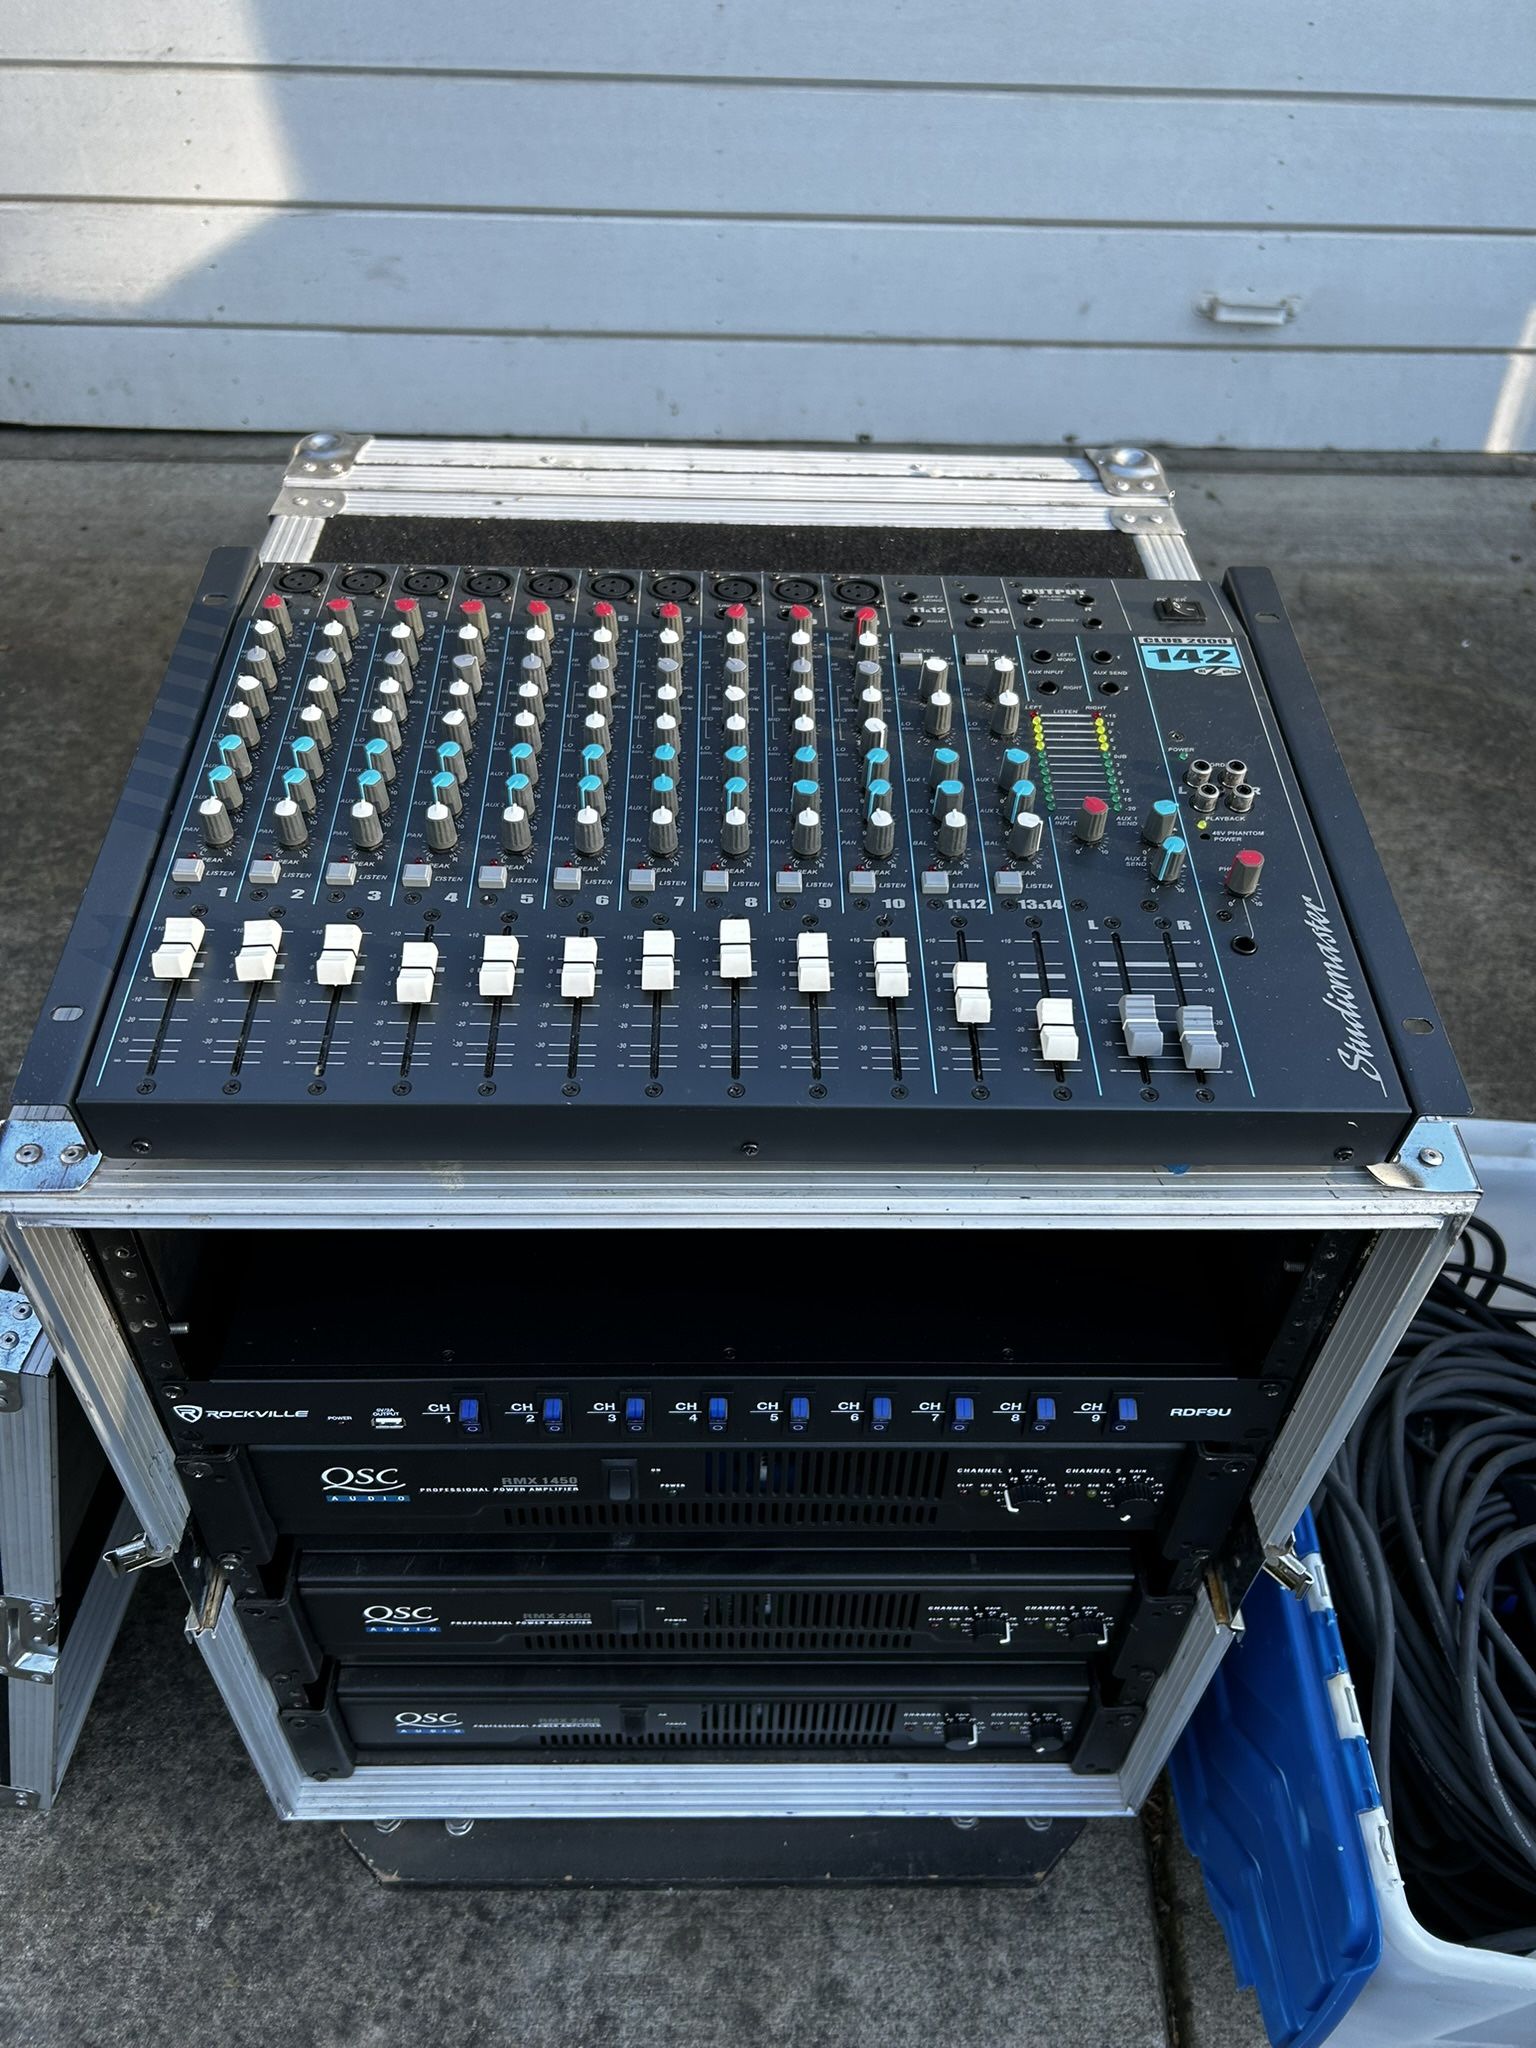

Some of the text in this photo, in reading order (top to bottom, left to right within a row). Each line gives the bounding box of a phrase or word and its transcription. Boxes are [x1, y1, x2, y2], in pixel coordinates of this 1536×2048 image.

[1148, 649, 1233, 663] 142
[217, 887, 229, 897] 1
[290, 889, 305, 899] 2
[367, 891, 382, 900] 3
[444, 893, 458, 902] 4
[520, 894, 534, 904] 5
[595, 895, 609, 905] 6
[673, 896, 685, 906] 7
[744, 897, 758, 907] 8
[818, 898, 832, 908] 9
[882, 899, 906, 909] 10
[945, 899, 987, 909] 11&12
[1018, 899, 1063, 910] 13&14
[1088, 920, 1099, 930] L
[1176, 920, 1192, 930] R
[1302, 894, 1388, 1098] Studiomaster
[427, 1403, 451, 1411] CH
[510, 1402, 534, 1411] CH
[593, 1402, 616, 1411] CH
[675, 1402, 697, 1411] CH
[757, 1402, 779, 1411] CH
[838, 1402, 860, 1411] CH
[919, 1402, 941, 1411] CH
[1000, 1402, 1022, 1411] CH
[1081, 1402, 1102, 1412] CH
[206, 1410, 309, 1419] ROCKVILLE
[1170, 1408, 1231, 1417] RDF9U
[444, 1415, 452, 1423] 1
[526, 1414, 535, 1422] 2
[608, 1414, 617, 1422] 3
[689, 1413, 698, 1422] 4
[770, 1414, 779, 1422] 5
[850, 1414, 859, 1422] 6
[931, 1414, 940, 1422] 7
[1011, 1414, 1020, 1422] 8
[1091, 1414, 1101, 1422] 9
[321, 1467, 406, 1492] QSC
[363, 1605, 439, 1624] QSC
[395, 1712, 463, 1727] QSC
